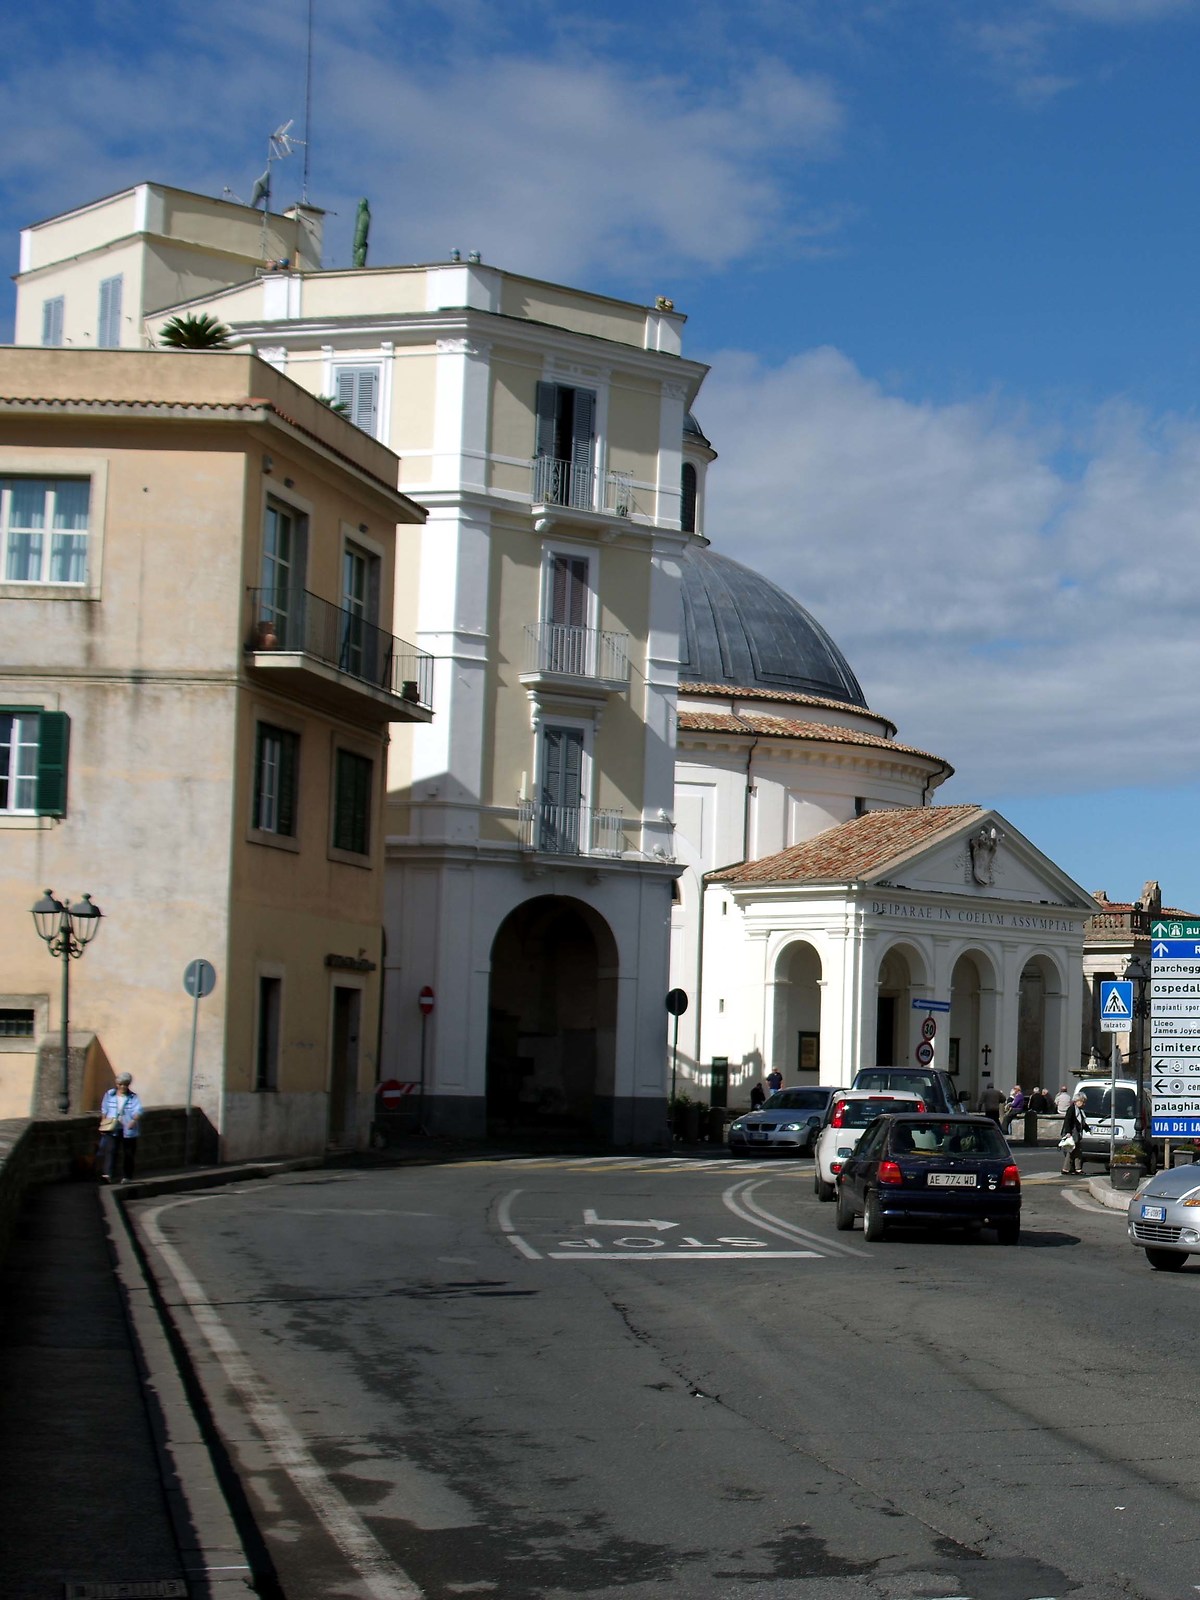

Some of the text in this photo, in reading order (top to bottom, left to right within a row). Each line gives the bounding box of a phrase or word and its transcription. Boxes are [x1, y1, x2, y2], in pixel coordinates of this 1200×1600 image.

[872, 901, 1074, 932] DEIPARAE IN COELVM ASSVMPTAE
[1153, 1004, 1182, 1012] impianti
[924, 1023, 934, 1035] 30
[1154, 1122, 1169, 1132] VIA
[1172, 1122, 1187, 1132] DEI
[930, 1175, 940, 1184] AE
[946, 1175, 961, 1184] 774
[558, 1237, 768, 1248] STOP
